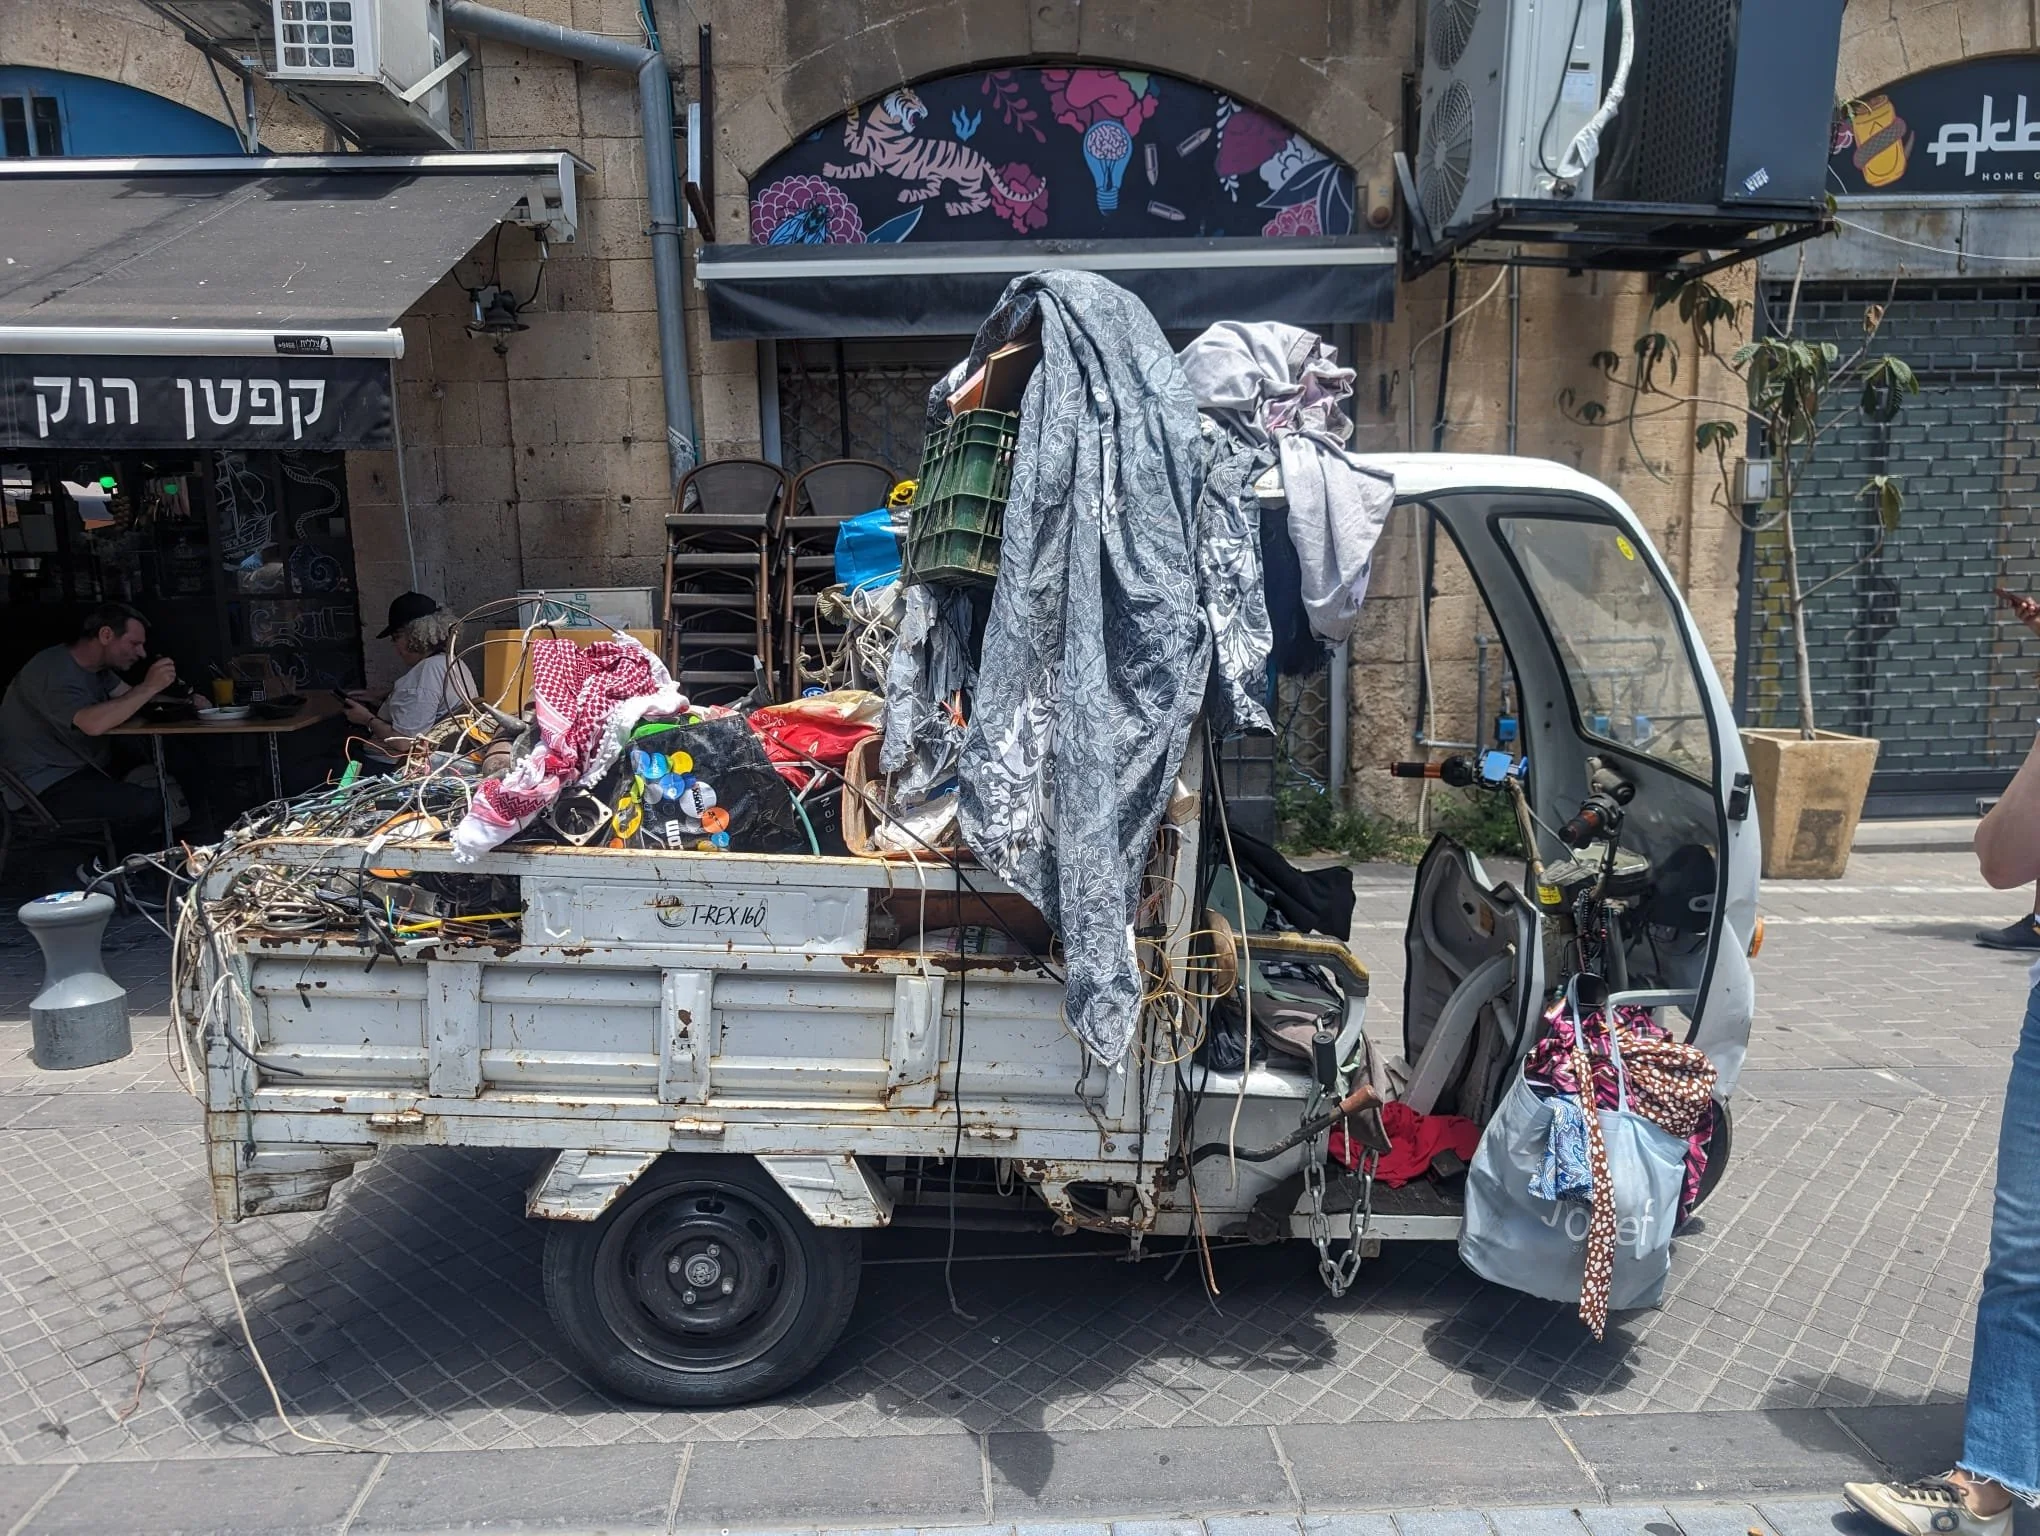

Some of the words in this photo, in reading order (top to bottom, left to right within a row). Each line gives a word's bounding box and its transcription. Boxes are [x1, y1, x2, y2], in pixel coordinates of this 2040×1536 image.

[1982, 172, 2024, 181] HOME
[33, 376, 139, 438] הוק
[176, 378, 326, 440] קפטן
[691, 904, 739, 925] T-REX
[740, 905, 766, 927] 160
[1541, 1198, 1655, 1246] Joef
